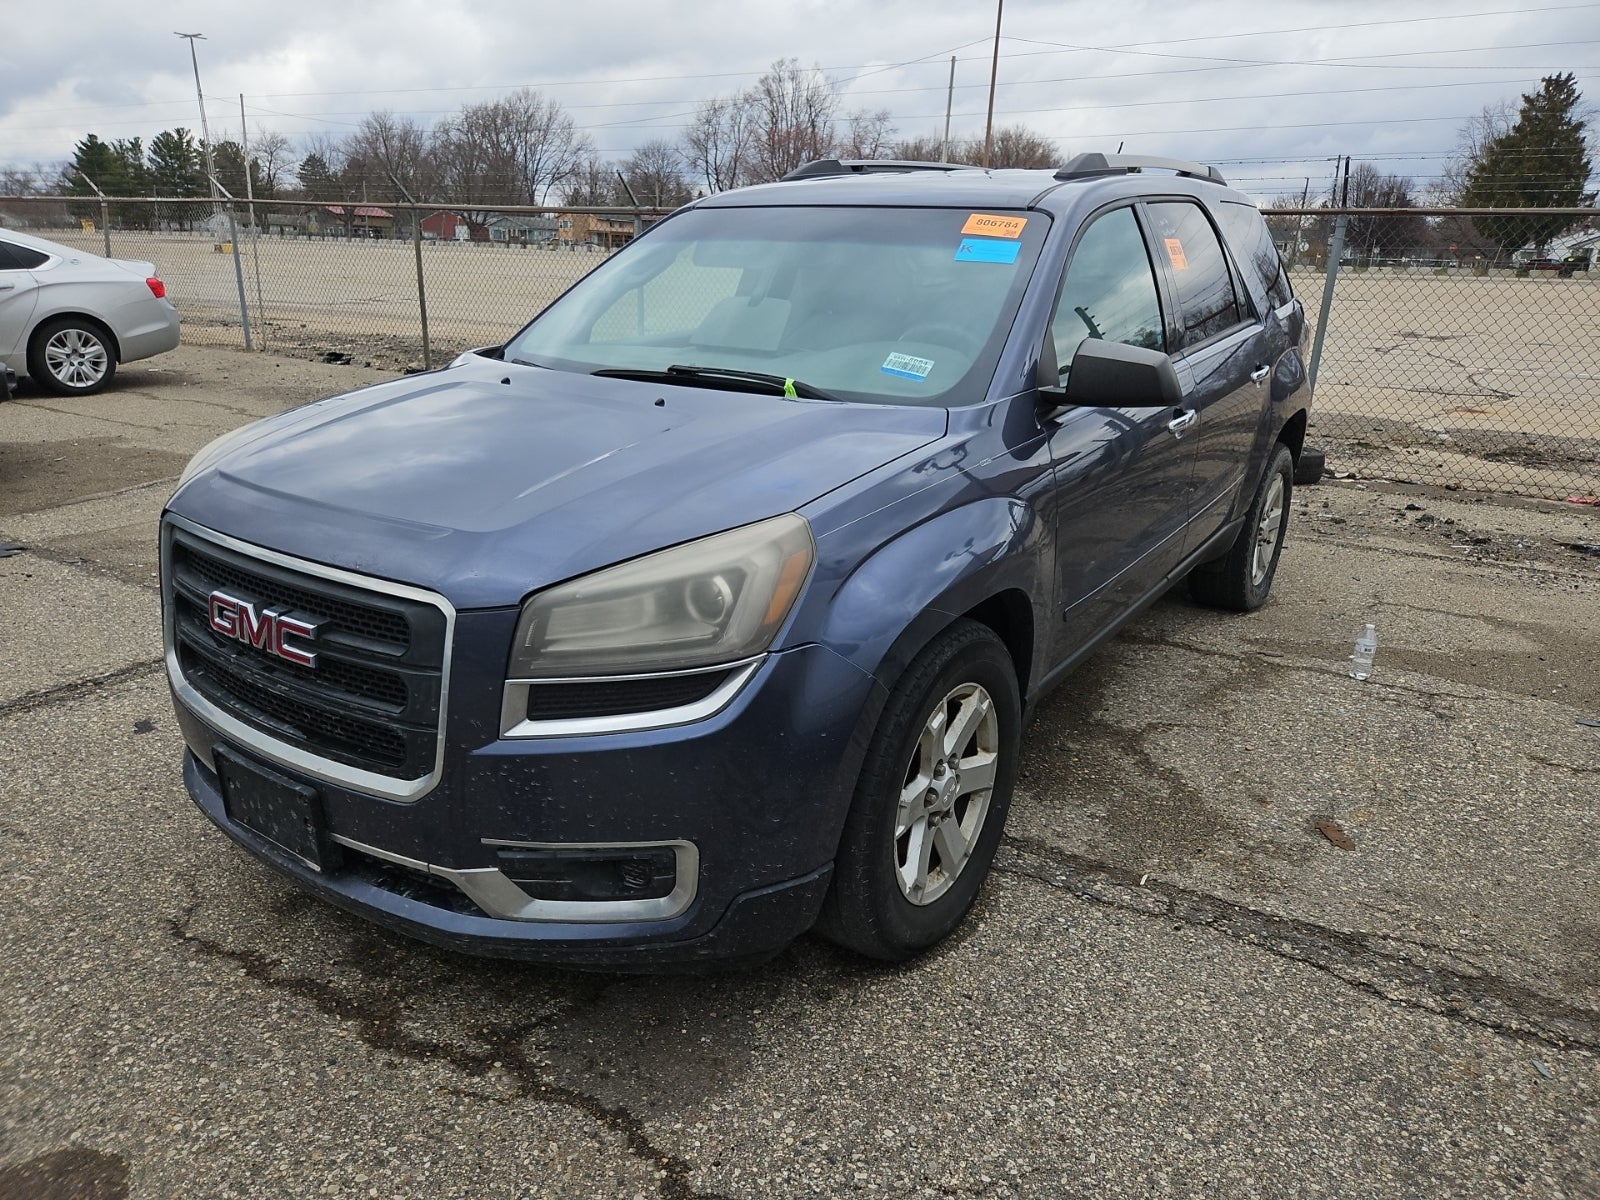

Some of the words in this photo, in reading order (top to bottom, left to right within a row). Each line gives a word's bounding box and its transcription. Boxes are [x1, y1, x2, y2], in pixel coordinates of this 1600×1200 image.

[976, 219, 1018, 229] 806784
[960, 245, 973, 253] K
[208, 590, 317, 669] GMC
